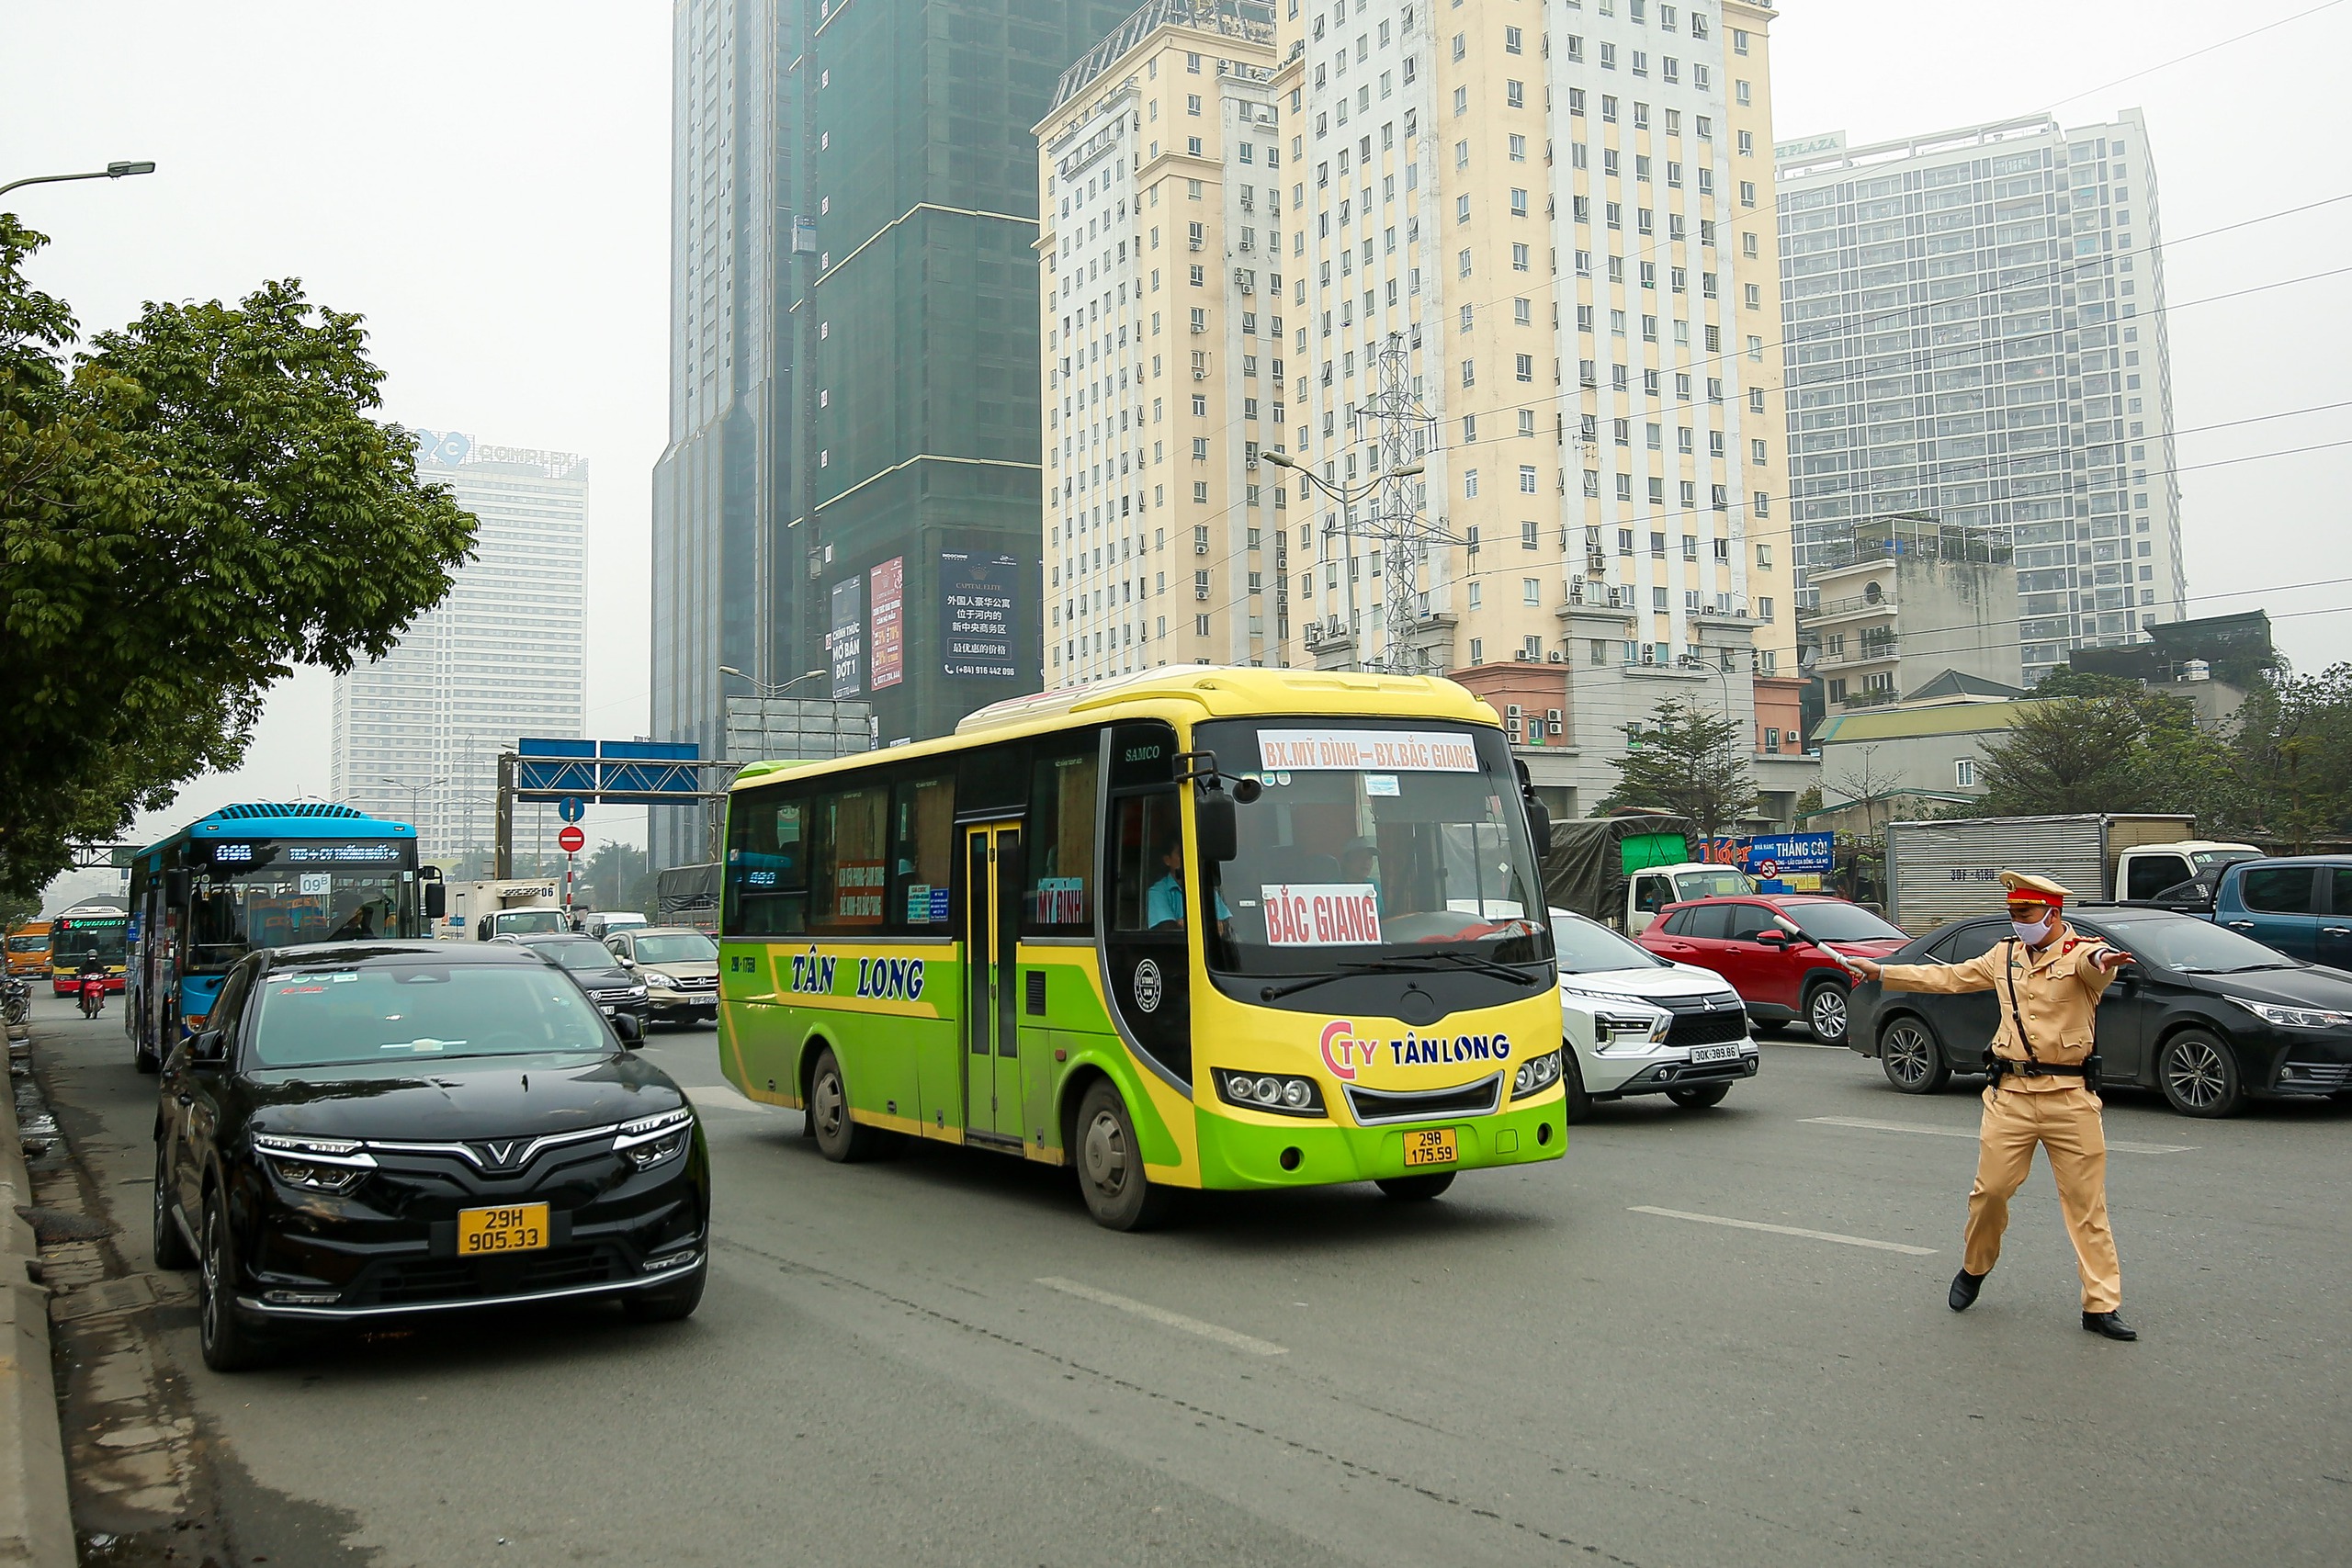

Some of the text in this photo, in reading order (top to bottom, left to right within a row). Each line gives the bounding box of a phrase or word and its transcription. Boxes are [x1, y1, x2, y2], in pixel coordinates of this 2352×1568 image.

[1788, 138, 1839, 156] PLAZA
[478, 445, 572, 467] COMPLEX
[946, 595, 1012, 608] 外国人豪华公寓
[956, 608, 1002, 621] 位于河内的
[952, 622, 1007, 634] 新中央商务区
[832, 639, 844, 662] MỞ
[844, 637, 860, 658] BÁN
[953, 643, 1006, 655] 最优惠的价格
[852, 660, 856, 674] 1
[956, 665, 974, 674] (+84)
[975, 666, 988, 674] 916
[989, 667, 1001, 675] 442
[1125, 745, 1160, 762] SAMCO
[1264, 738, 1317, 767] BX.MỸ
[1319, 737, 1359, 766] ĐÌNH
[1374, 735, 1428, 767] BX.BẮC
[1430, 744, 1476, 769] GIANG
[1776, 837, 1809, 857] THẮNG
[1037, 880, 1083, 924] MỸ ĐÌNH
[1266, 885, 1378, 943] BẮC GIANG
[791, 942, 924, 1001] TÂN LONG
[1419, 1132, 1442, 1146] 29B
[1411, 1146, 1453, 1164] 175.59
[485, 1209, 523, 1229] 29H
[469, 1228, 538, 1251] 905.33
